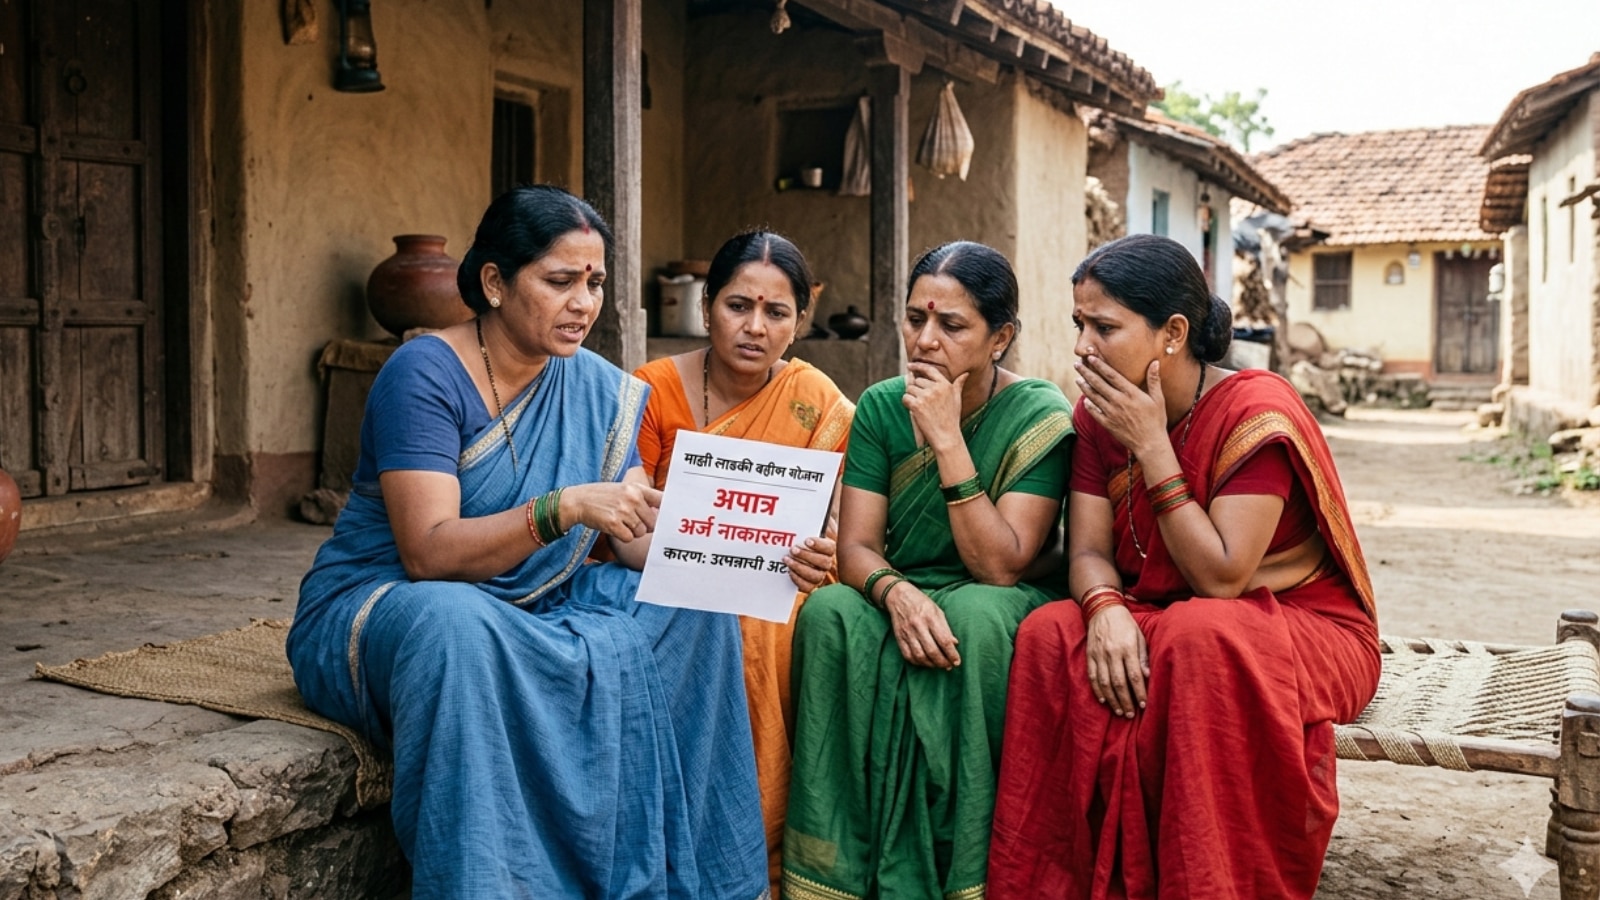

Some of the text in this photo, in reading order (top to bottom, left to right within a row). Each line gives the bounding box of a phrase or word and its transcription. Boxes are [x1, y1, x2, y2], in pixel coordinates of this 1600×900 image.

[684, 452, 713, 467] माझी
[713, 488, 779, 516] अपात्र
[678, 516, 797, 548] अर्ज नाकारला
[663, 547, 706, 563] कारण:
